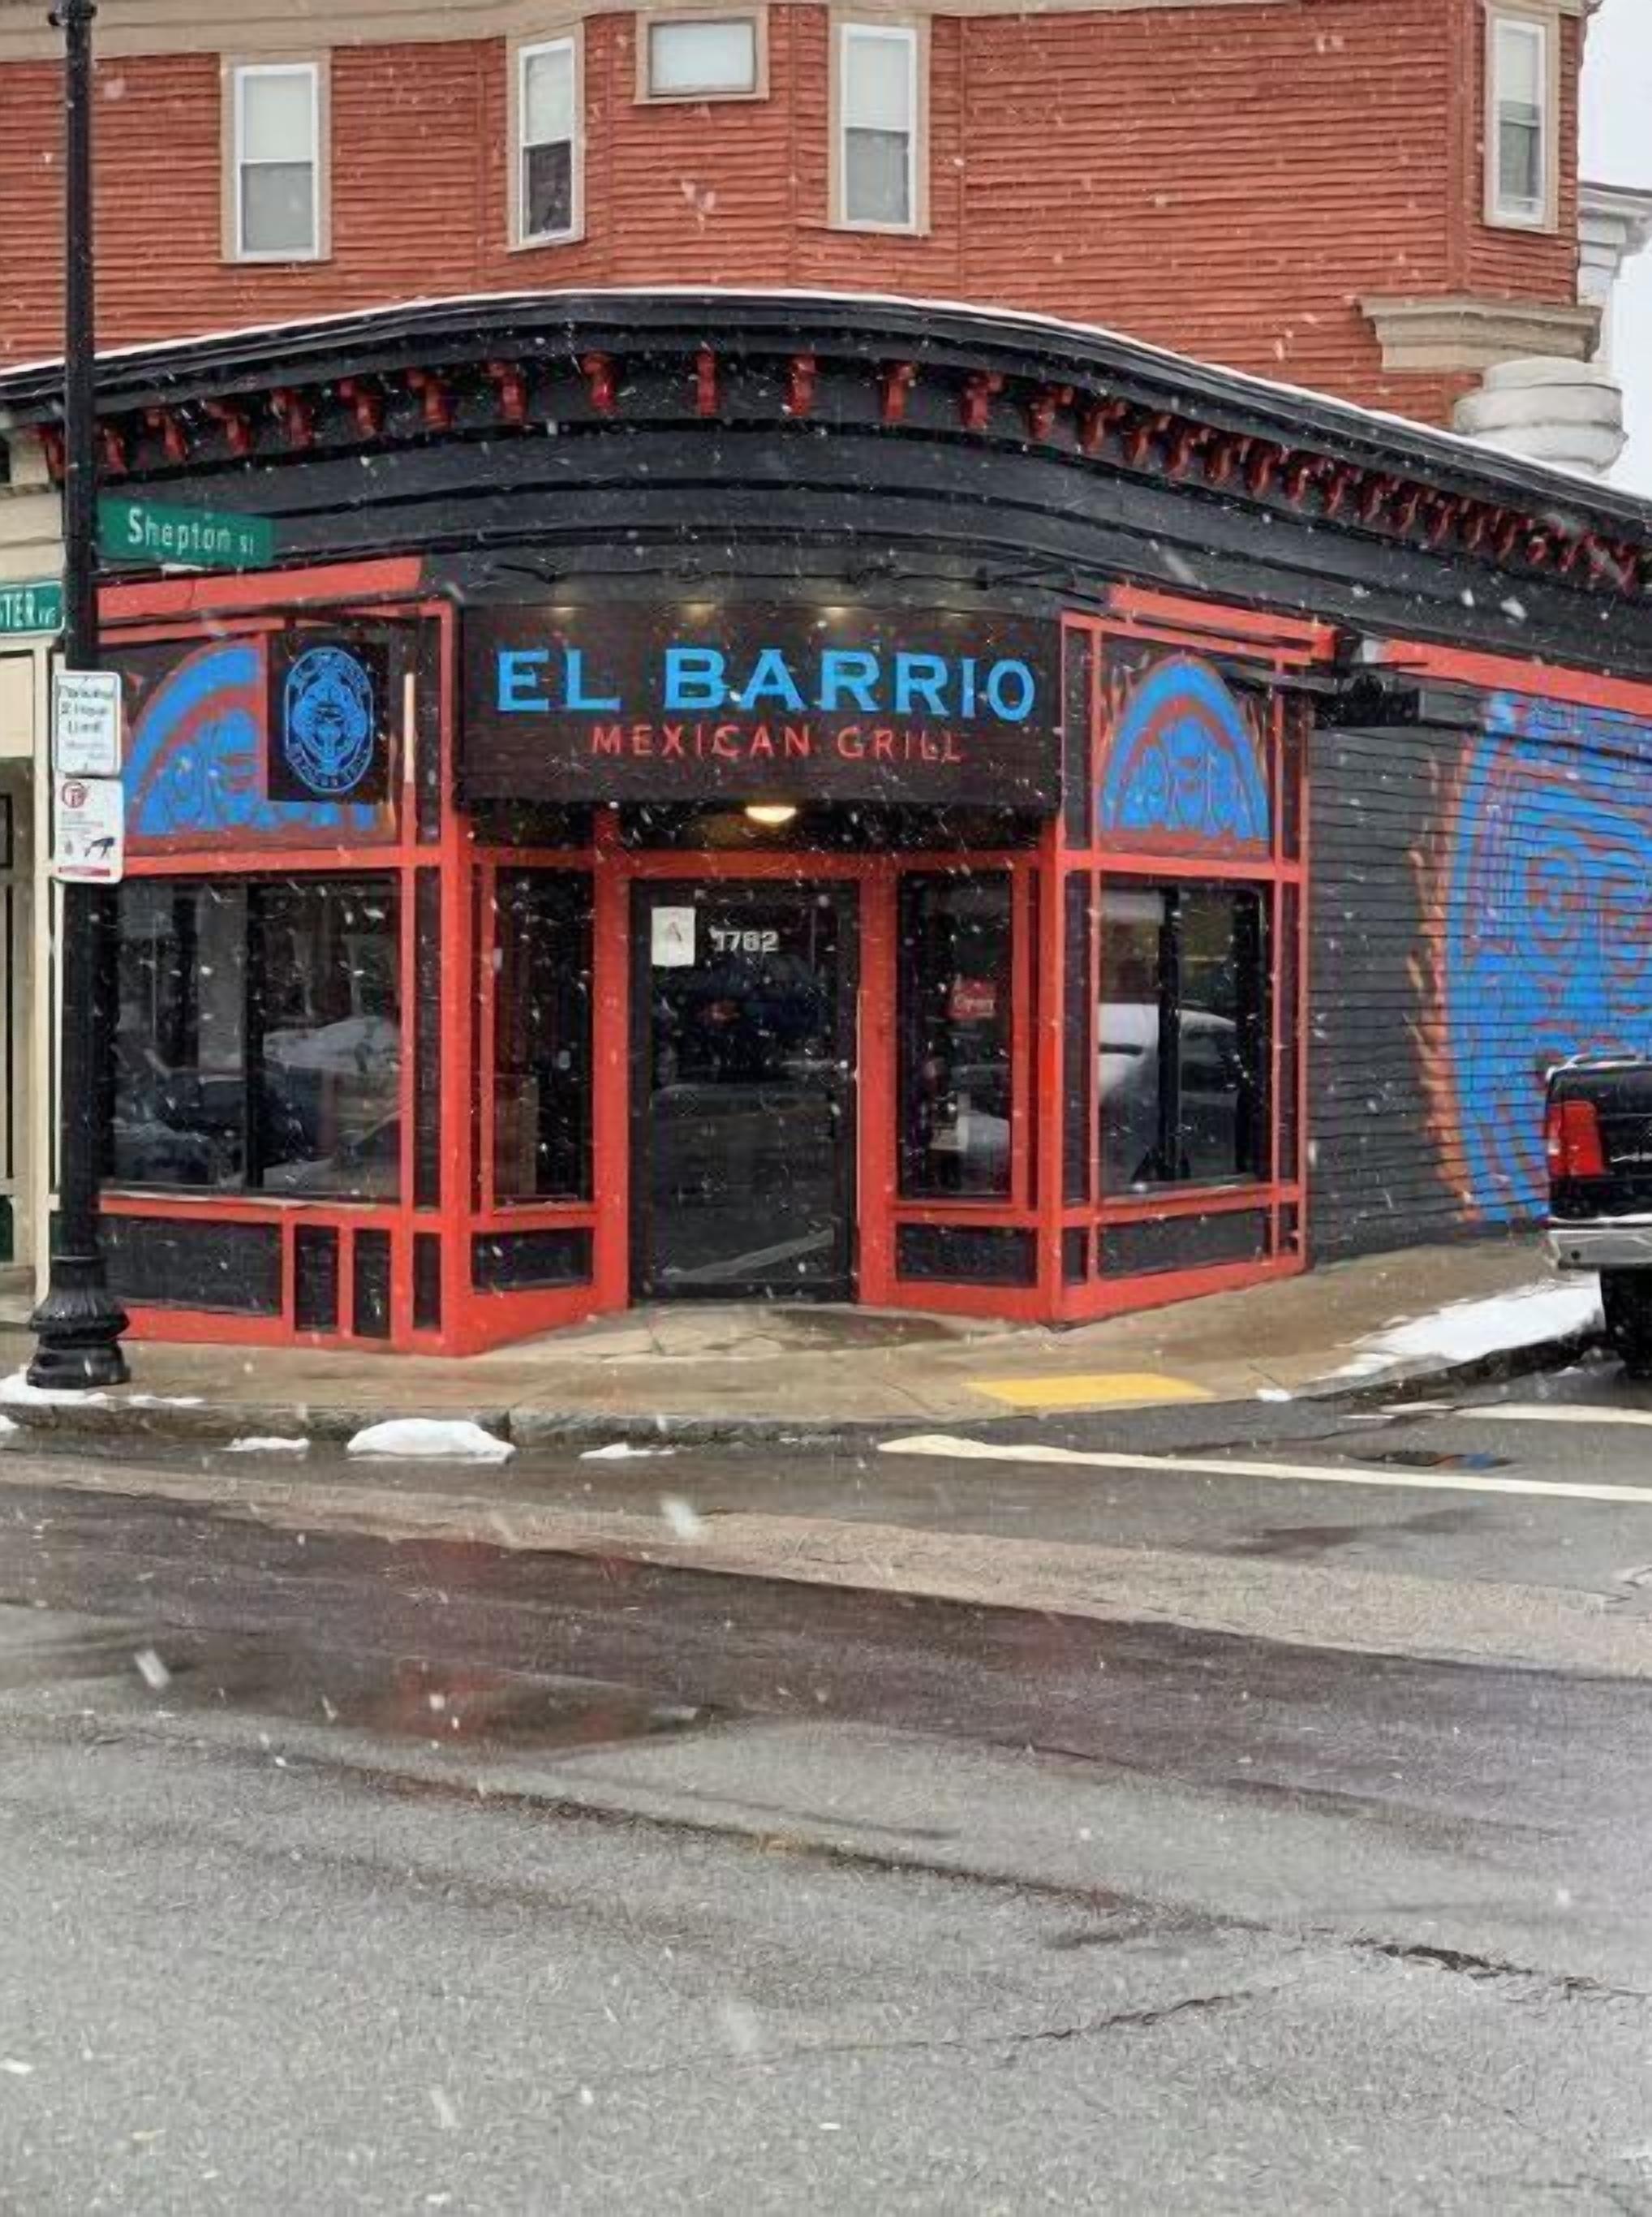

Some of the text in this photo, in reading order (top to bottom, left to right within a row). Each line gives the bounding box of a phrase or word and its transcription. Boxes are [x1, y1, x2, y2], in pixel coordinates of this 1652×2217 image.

[127, 506, 231, 556] Shepton
[0, 593, 35, 628] TER
[496, 648, 1036, 722] EL BARRIO
[591, 725, 963, 764] MEXICAN GRILL
